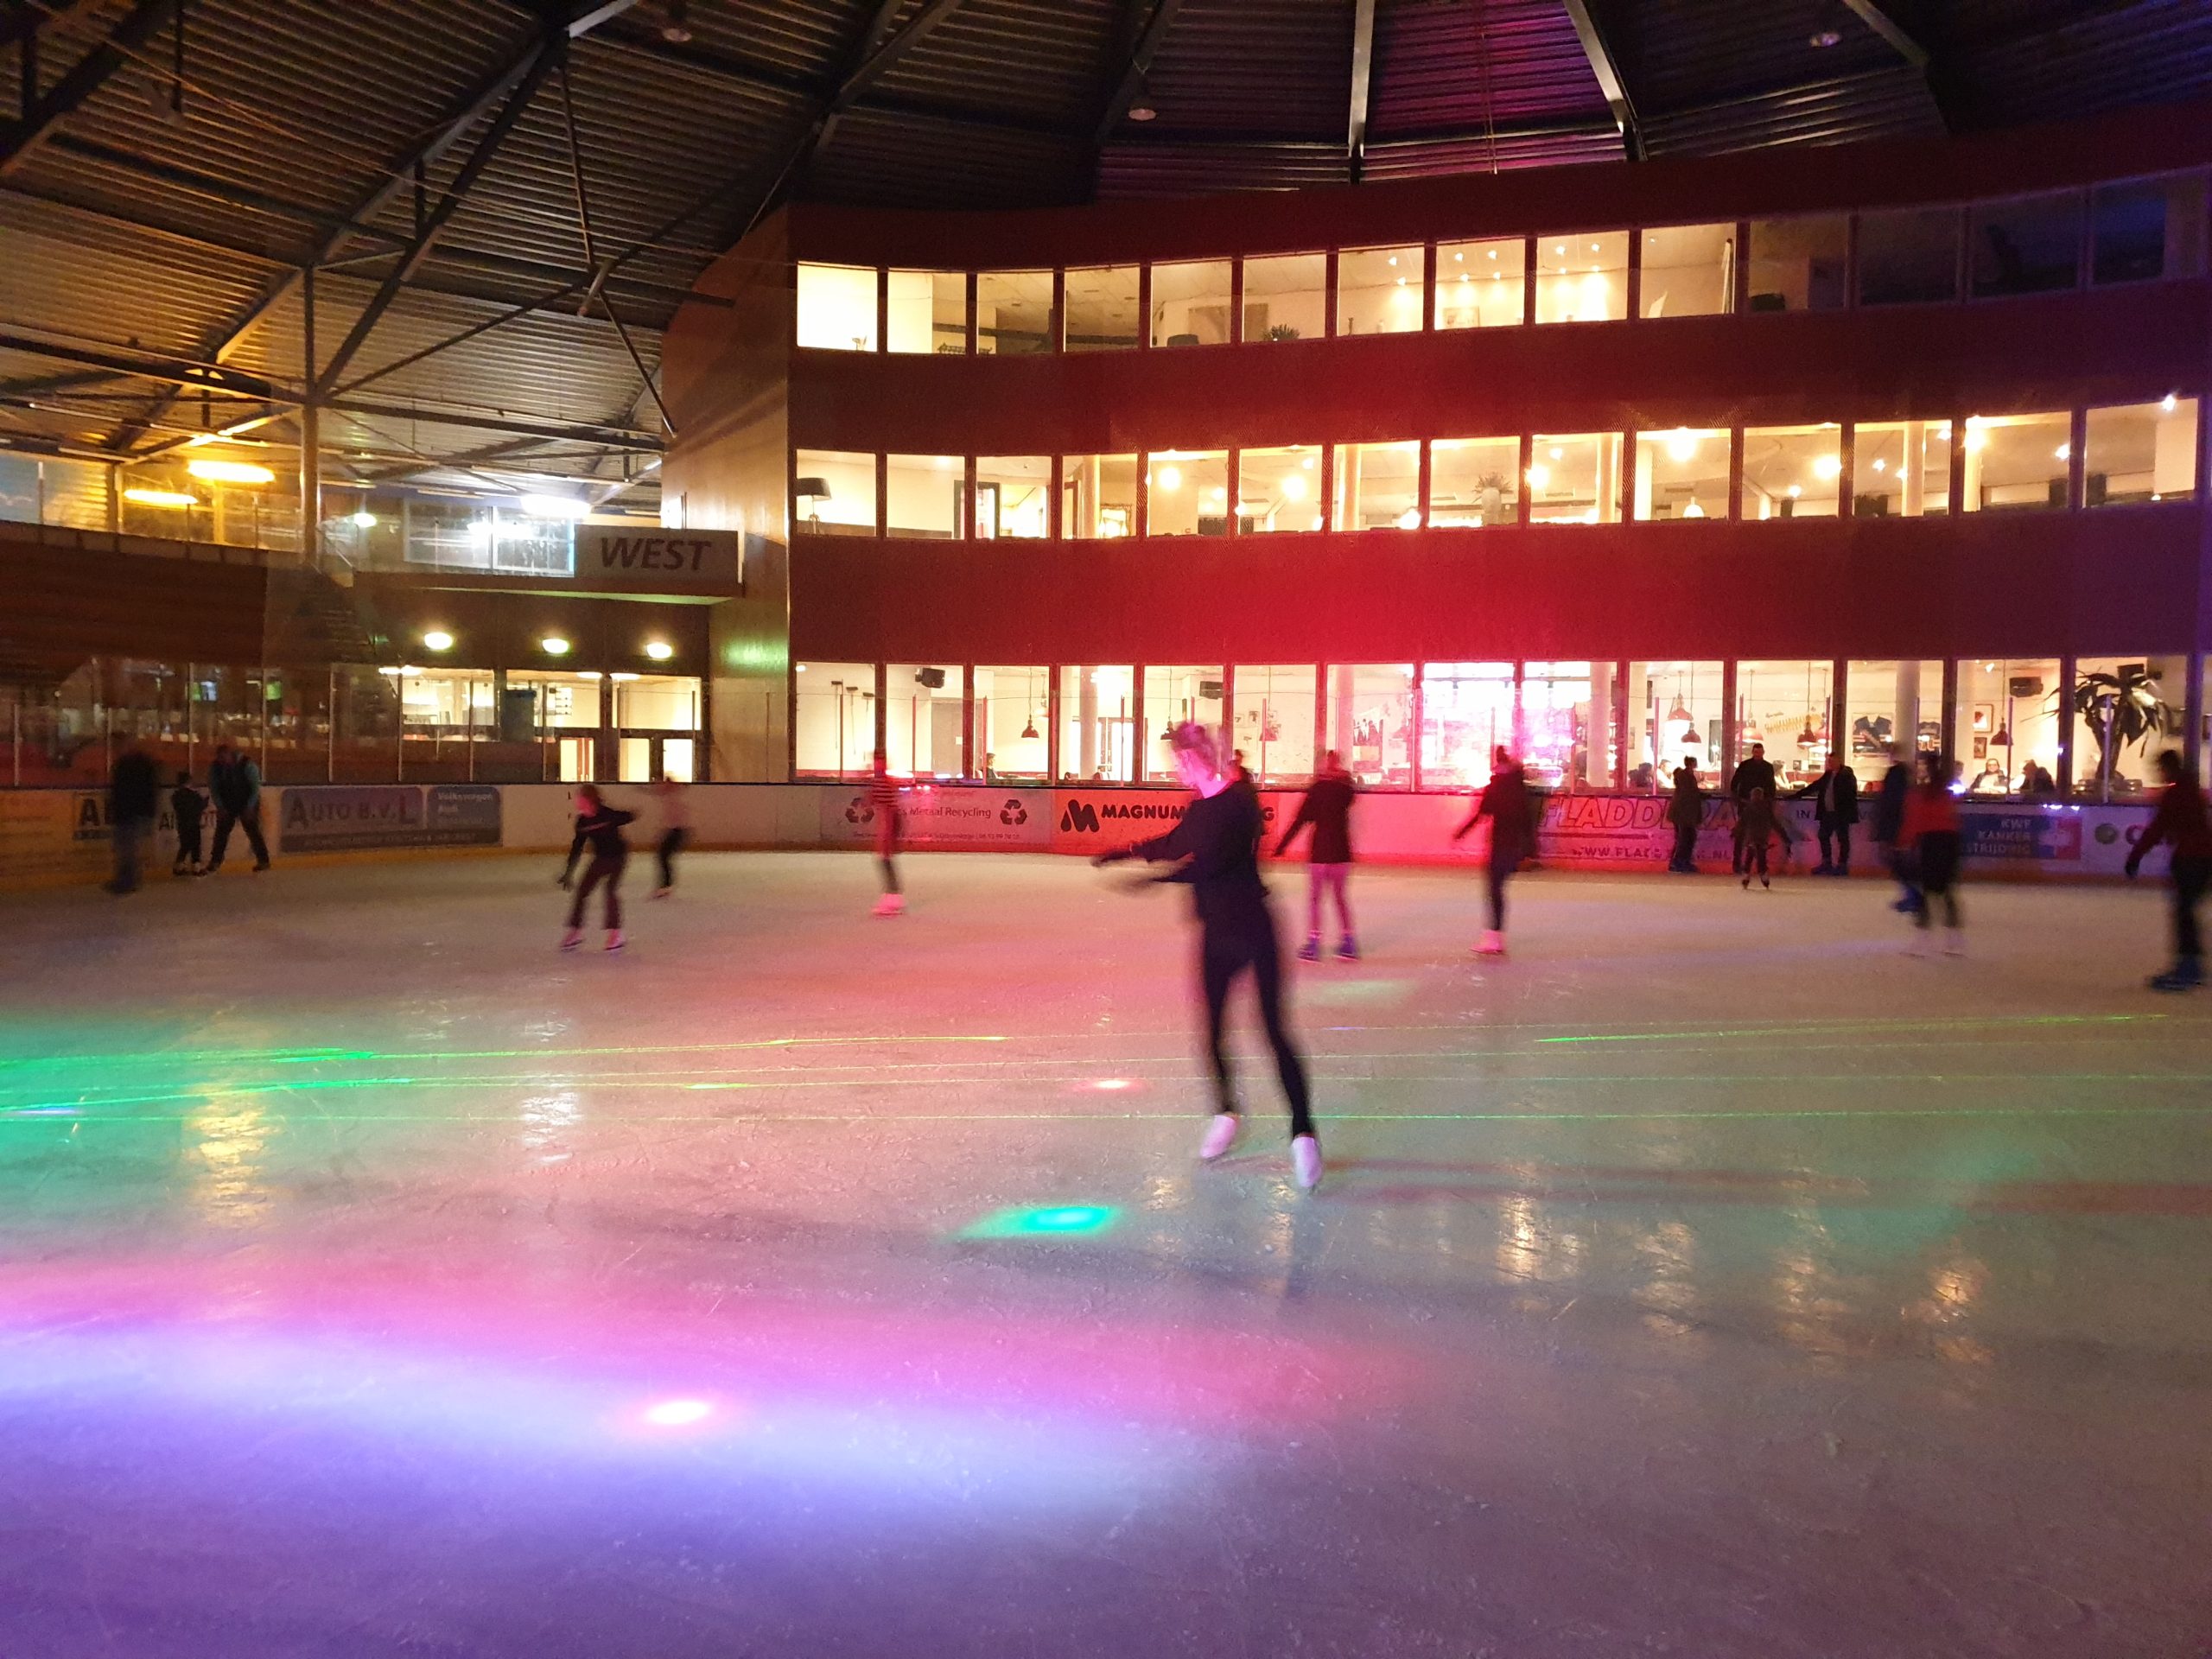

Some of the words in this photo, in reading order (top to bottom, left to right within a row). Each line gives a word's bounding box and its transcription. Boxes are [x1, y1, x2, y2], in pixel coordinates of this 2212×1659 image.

[601, 537, 712, 571] WEST
[945, 806, 991, 819] Recycling
[1101, 804, 1186, 820] MAGNUM
